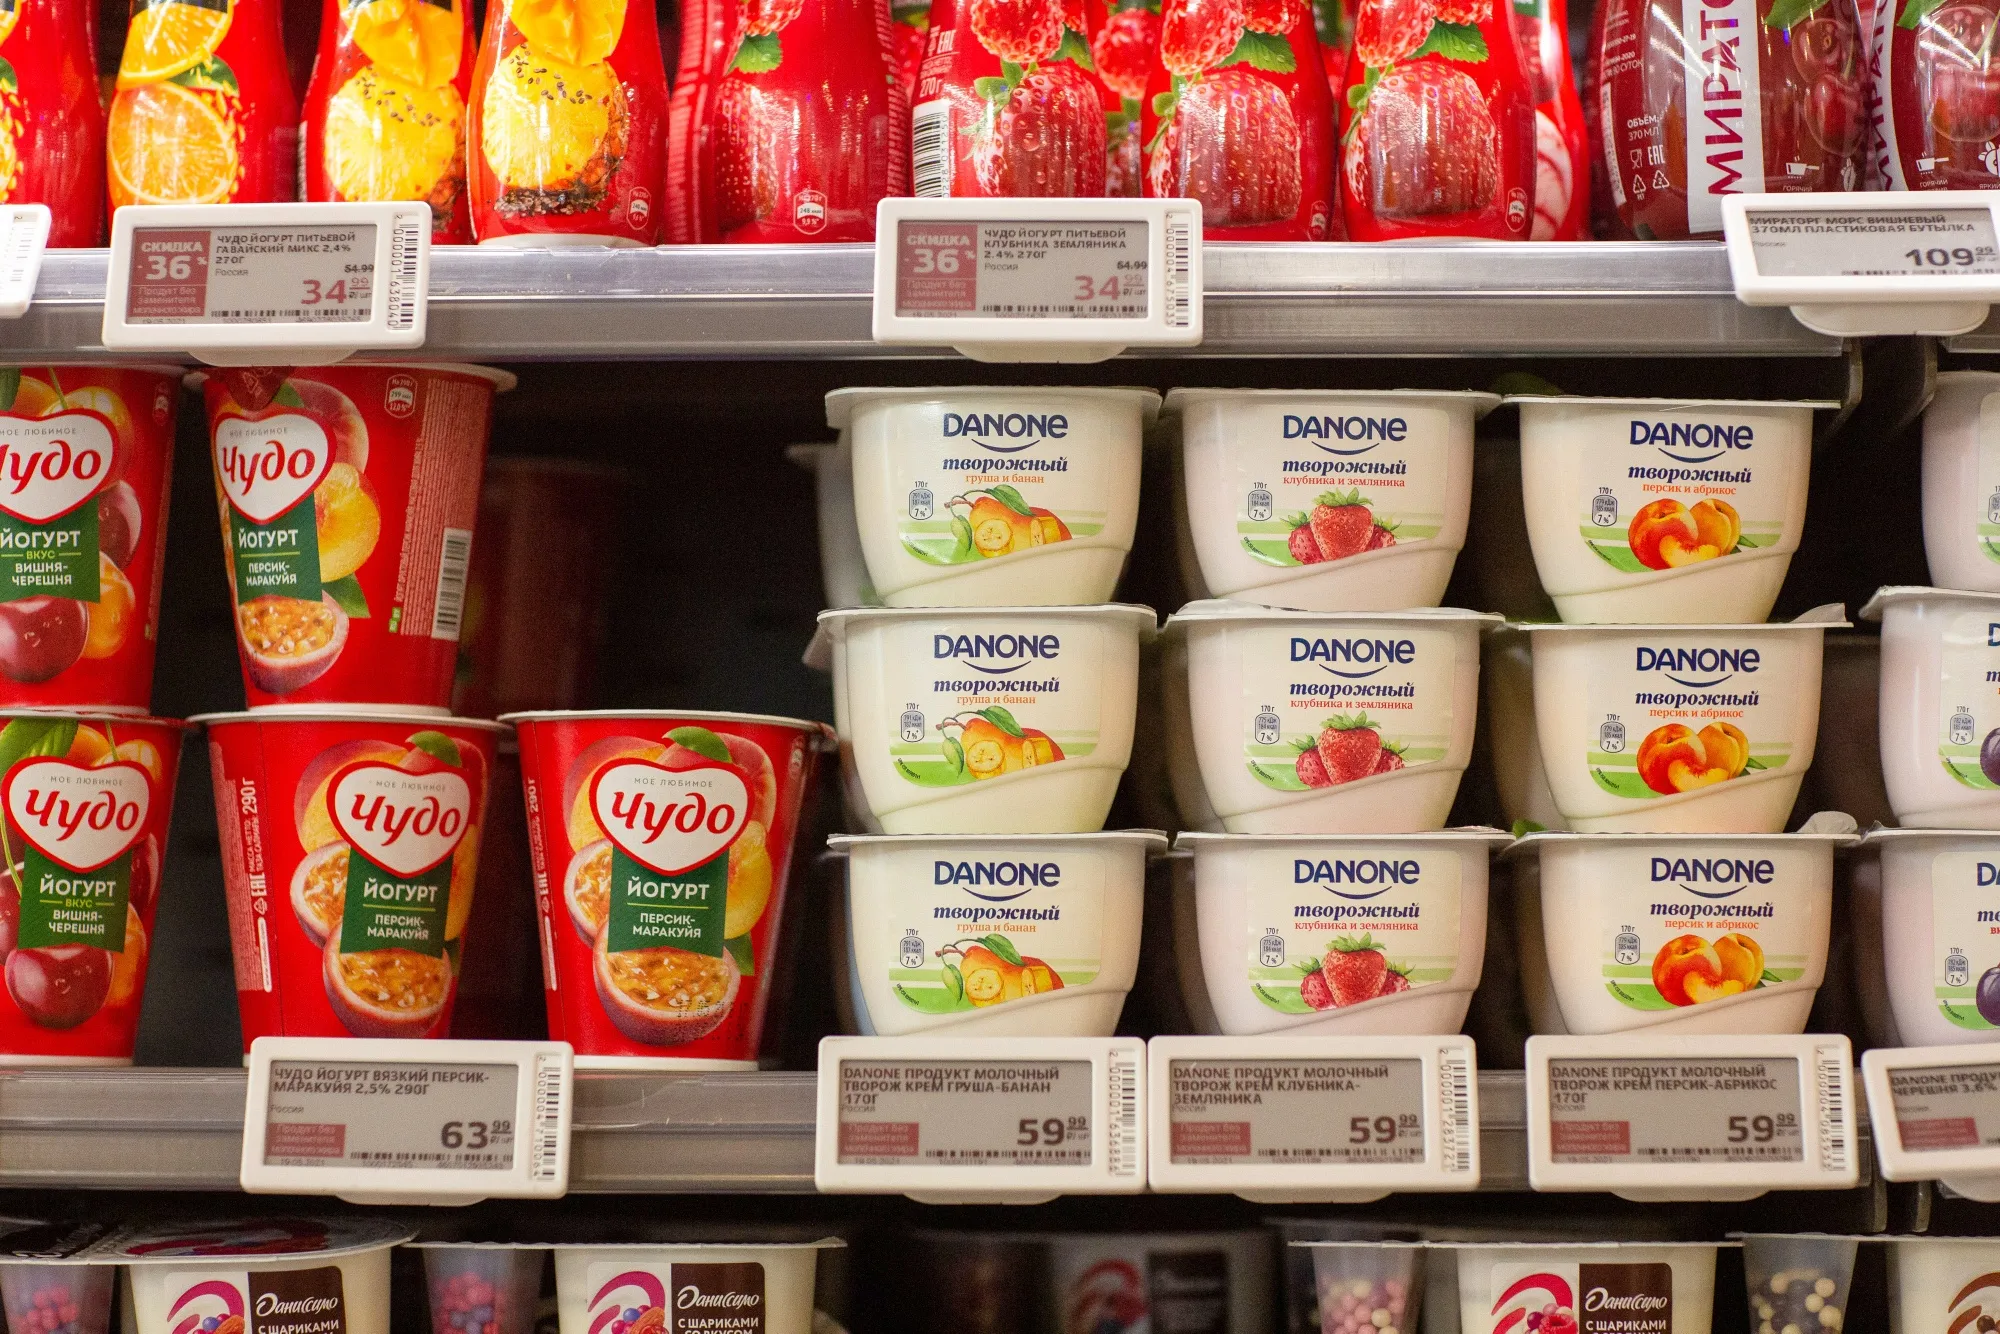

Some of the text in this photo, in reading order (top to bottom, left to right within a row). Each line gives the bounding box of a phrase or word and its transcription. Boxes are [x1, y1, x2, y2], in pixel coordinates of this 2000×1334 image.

[1700, 0, 1745, 195] МИРАТ
[1628, 126, 1660, 141] 370 МЛ
[1750, 214, 1946, 225] МИРАТОРГ МОРС ВИШНЕВЫЙ
[984, 228, 1126, 239] ЧУДО ЙОГУРТ ПИТЬЕВОЙ
[1752, 223, 1975, 234] 370МЛ ПЛАСТИКОВАЯ БУТЫЛКА
[217, 231, 356, 244] ЧУДО ЙОГУРТ ПИТЬЕВОЙ
[906, 234, 970, 246] СКИДКА
[141, 241, 203, 253] СКИДКА
[216, 243, 351, 254] ГАВАЙСКИЙ МИКС 2,4%
[984, 240, 1127, 249] КЛУБНИКА ЗЕМЛЯНИКА
[215, 256, 244, 264] 270Г
[1017, 250, 1047, 259] 270Г
[1905, 248, 1974, 266] 109
[301, 279, 345, 304] 34
[1074, 275, 1120, 300] 34
[221, 440, 316, 496] Чудо
[943, 456, 1068, 473] творожный
[1283, 459, 1407, 476] творожный
[965, 475, 999, 485] груша
[1012, 473, 1044, 484] банан
[1628, 465, 1752, 484] творожный
[1283, 476, 1335, 486] клубника
[1348, 478, 1405, 487] земляника
[1643, 483, 1681, 494] персик
[1693, 484, 1737, 496] абрикос
[0, 529, 81, 549] ЙОГУРТ
[238, 528, 298, 549] ЙОГУРТ
[26, 550, 56, 559] ВКУС
[15, 562, 68, 573] ВИШНЯ-
[248, 562, 290, 574] ПЕРСИК-
[12, 574, 72, 586] ЧЕРЕШНЯ
[246, 572, 297, 586] МАРАКУЙЯ
[933, 677, 1060, 695] творожный
[1289, 681, 1415, 699] творожный
[956, 696, 991, 705] груша
[1003, 694, 1036, 704] банан
[1290, 698, 1343, 709] клубника
[1355, 700, 1413, 710] земляника
[1635, 690, 1759, 708] творожный
[1650, 708, 1689, 718] персик
[1700, 708, 1744, 719] абрикос
[50, 775, 123, 786] МОЕ ЛЮБИМОЕ
[376, 780, 396, 788] МОЕ
[634, 777, 714, 788] МОЕ ЛЮБИМОЕ
[25, 789, 140, 841] Чудо
[351, 793, 461, 846] Чудо
[611, 792, 735, 844] Чудо
[40, 874, 116, 897] ЙОГУРТ
[363, 877, 438, 902] ЙОГУРТ
[627, 876, 710, 900] ЙОГУРТ
[65, 898, 93, 908] ВКУС
[53, 909, 103, 921] ВИШНЯ-
[933, 905, 1060, 922] творожный
[1294, 903, 1420, 921] творожный
[1650, 901, 1773, 919] творожный
[375, 914, 425, 926] ПЕРСИК-
[640, 912, 695, 924] ПЕРСИК-
[49, 922, 105, 934] ЧЕРЕШНЯ
[956, 923, 991, 933] груша
[1003, 922, 1036, 933] банан
[1295, 920, 1347, 931] клубника
[1360, 922, 1419, 931] земляника
[1665, 919, 1704, 929] персик
[1716, 919, 1759, 930] абрикос
[367, 926, 428, 940] МАРАКУЙЯ
[632, 925, 701, 938] МАРАКУЙЯ
[275, 1067, 489, 1084] ЧУДО ЙОГУРТ ВЯЗКИЙ ПЕРСИК-
[844, 1066, 1059, 1081] DANONE ПРОДУКТ МОЛОЧНЫЙ
[1173, 1065, 1388, 1081] DANONE ПРОДУКТ МОЛОЧНЫЙ
[1552, 1064, 1766, 1081] DANONE ПРОДУКТ МОЛОЧНЫЙ
[273, 1081, 429, 1096] МАРАКУЙЯ 2,5% 290Г
[845, 1081, 1051, 1093] ТВОРОЖ КРЕМ ГРУША-БАНАН
[1174, 1079, 1360, 1091] ТВОРОЖ КРЕМ КЛУБНИКА-
[1553, 1079, 1777, 1091] ТВОРОЖ КРЕМ ПЕРСИК-АБРИКОС
[845, 1093, 880, 1105] 170Г
[1174, 1093, 1263, 1104] ЗЕМЛЯНИКА
[1554, 1092, 1588, 1104] 170Г
[1067, 1117, 1087, 1126] 99
[1399, 1114, 1418, 1125] 99
[1776, 1113, 1796, 1124] 99
[491, 1120, 512, 1131] 99
[1349, 1116, 1397, 1144] 59
[1727, 1115, 1775, 1143] 59
[441, 1121, 489, 1149] 63
[1017, 1118, 1065, 1146] 59
[258, 1319, 339, 1334] С ШАРИКАМИ
[678, 1317, 759, 1329] С ШАРИКАМИ
[1585, 1319, 1667, 1331] С ШАРИКАМИ
